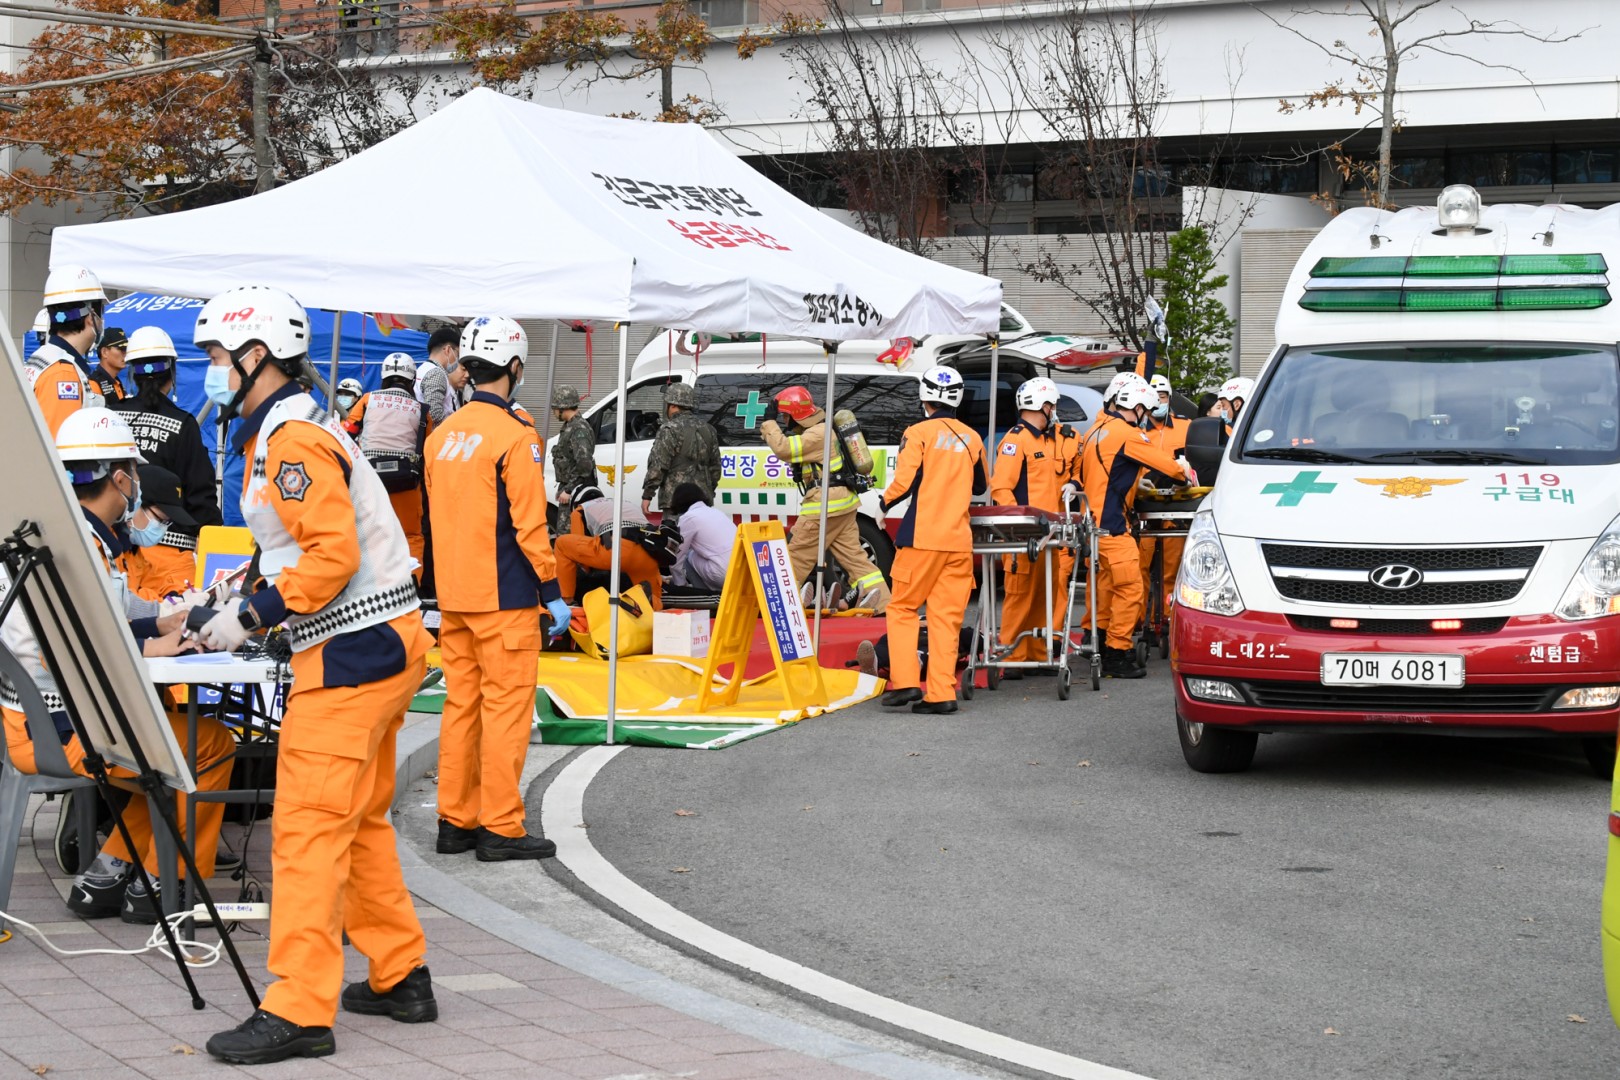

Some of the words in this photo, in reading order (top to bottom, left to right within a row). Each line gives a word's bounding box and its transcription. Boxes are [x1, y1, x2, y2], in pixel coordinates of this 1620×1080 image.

[591, 171, 763, 217] 긴급구조통제단
[667, 219, 792, 251] 응급의료소
[221, 306, 255, 323] 119
[435, 433, 483, 462] 119
[720, 455, 757, 478] 현장
[1495, 473, 1560, 486] 119
[1482, 487, 1575, 505] 구급대
[775, 547, 808, 649] 응급처치반
[762, 573, 789, 655] 해운대소방서
[768, 572, 794, 654] 긴급구조통제단
[1529, 645, 1581, 663] 센텀급
[1336, 659, 1379, 680] 70머
[1391, 659, 1447, 682] 6081
